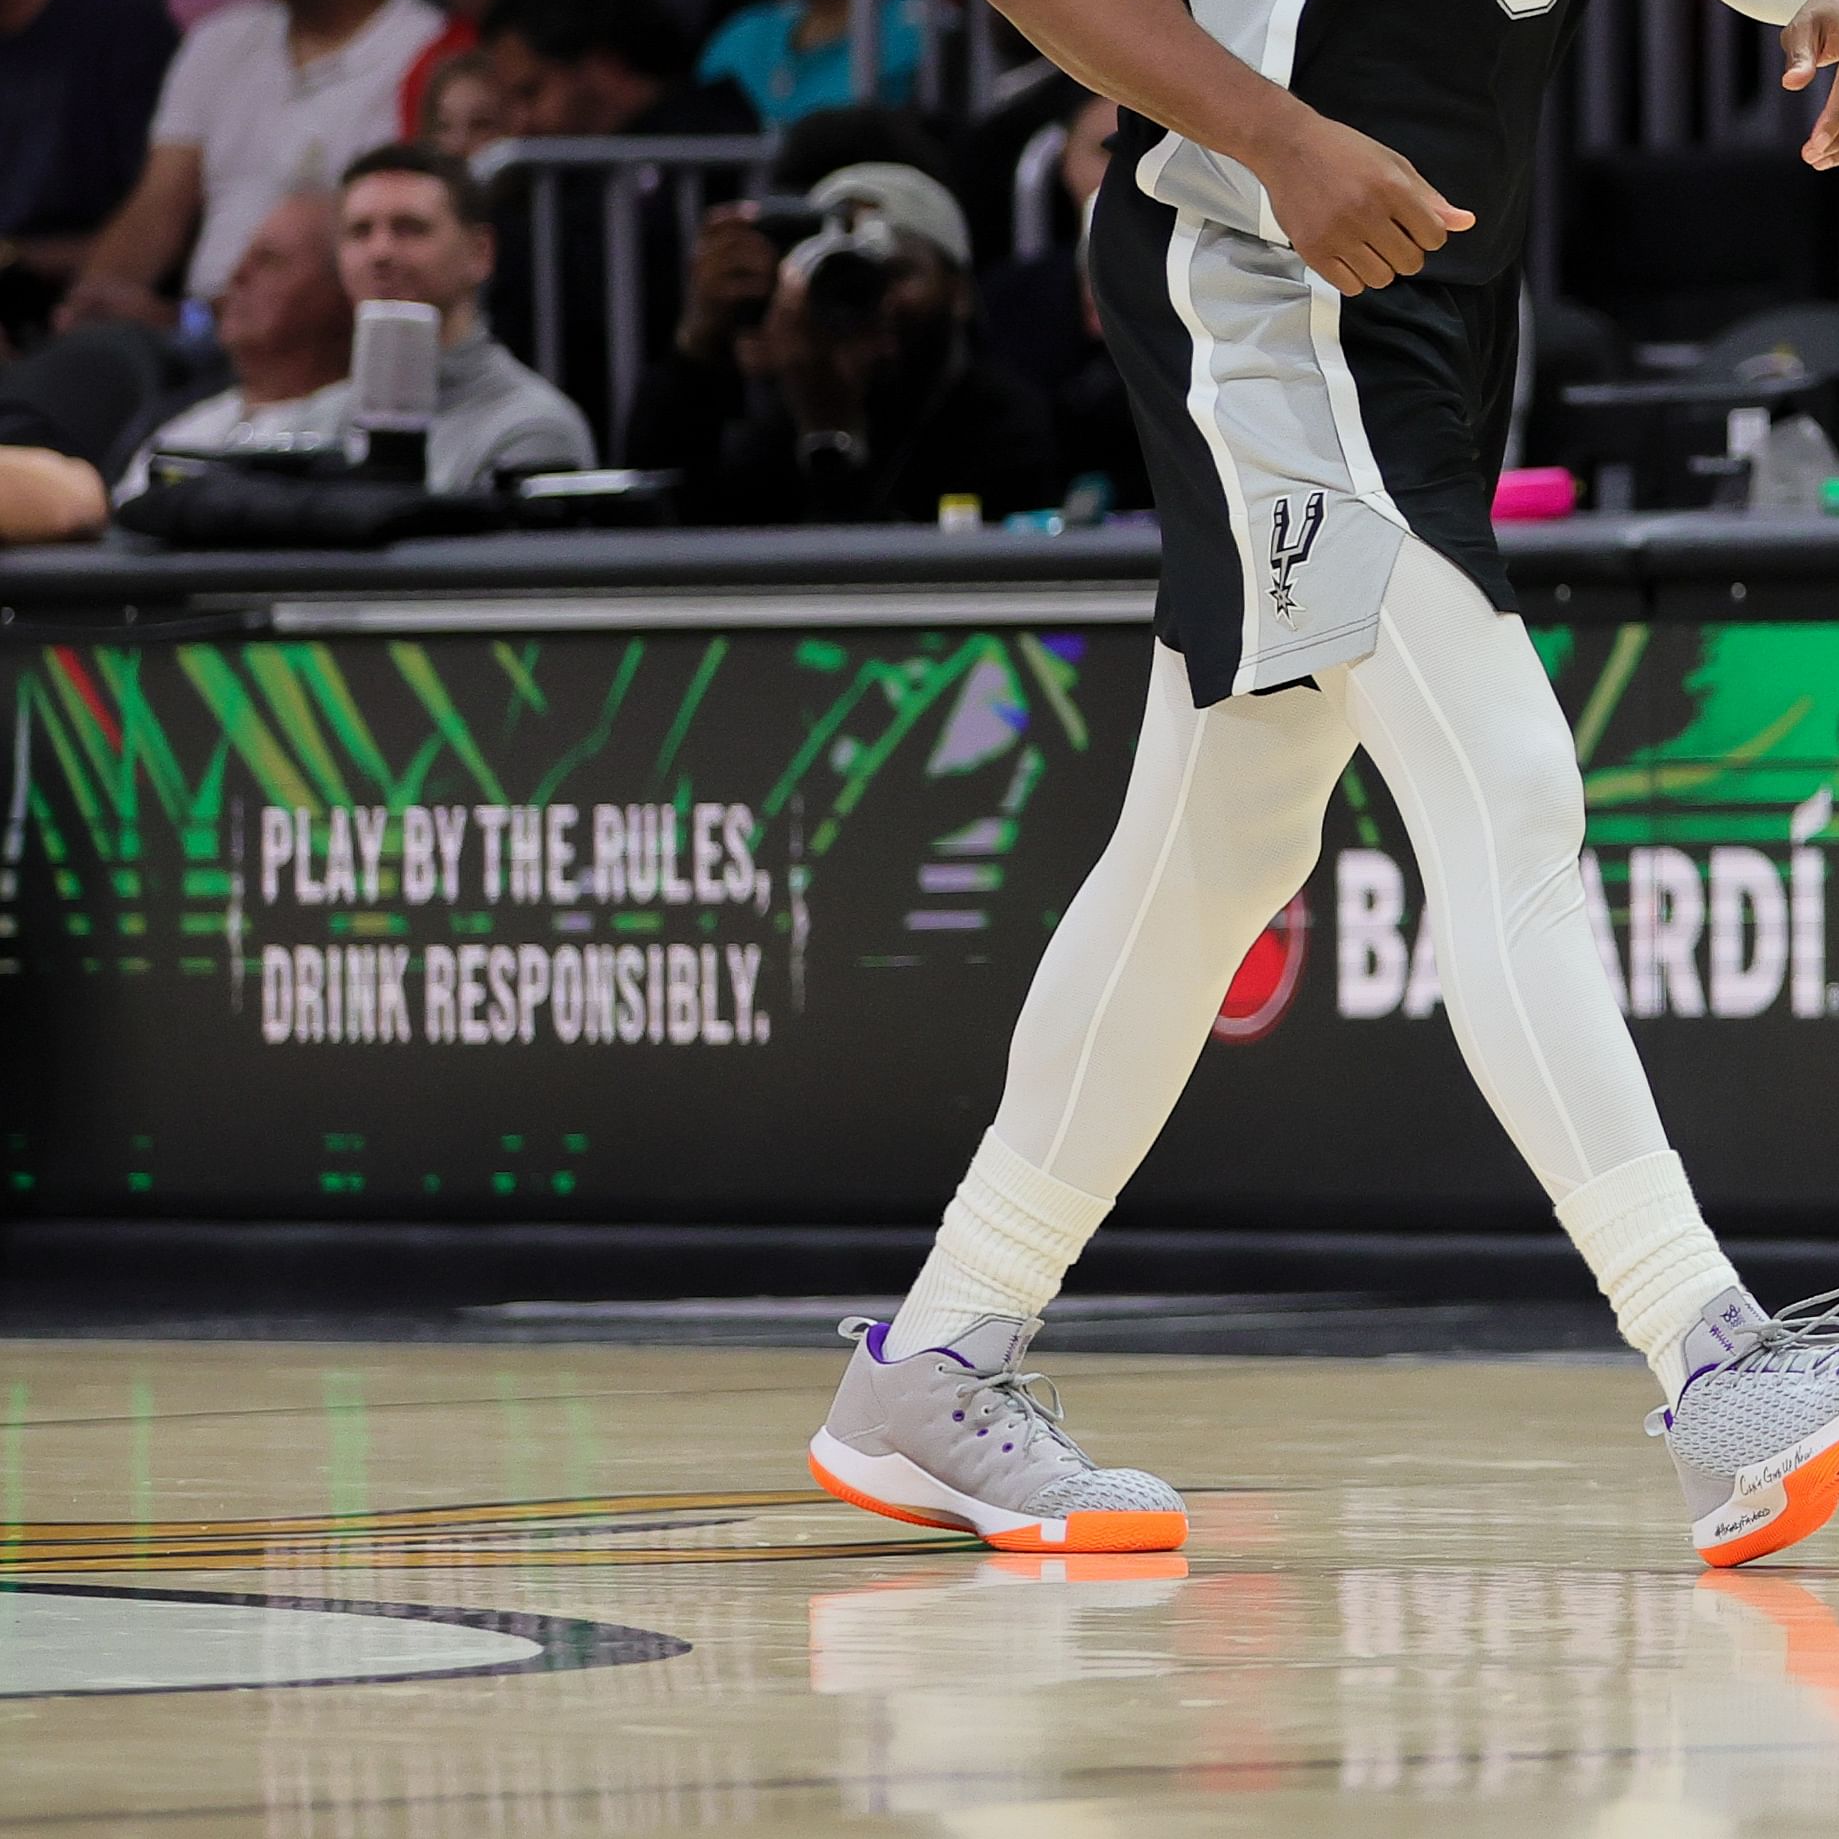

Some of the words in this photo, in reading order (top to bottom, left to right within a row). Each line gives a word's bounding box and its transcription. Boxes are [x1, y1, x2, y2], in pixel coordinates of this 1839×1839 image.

[260, 805, 387, 905] PLAY
[403, 805, 468, 905] BY
[473, 803, 580, 905] THE
[593, 802, 772, 917] RULES,
[261, 943, 412, 1045] DRINK
[423, 943, 772, 1046] RESPONSIBLY.
